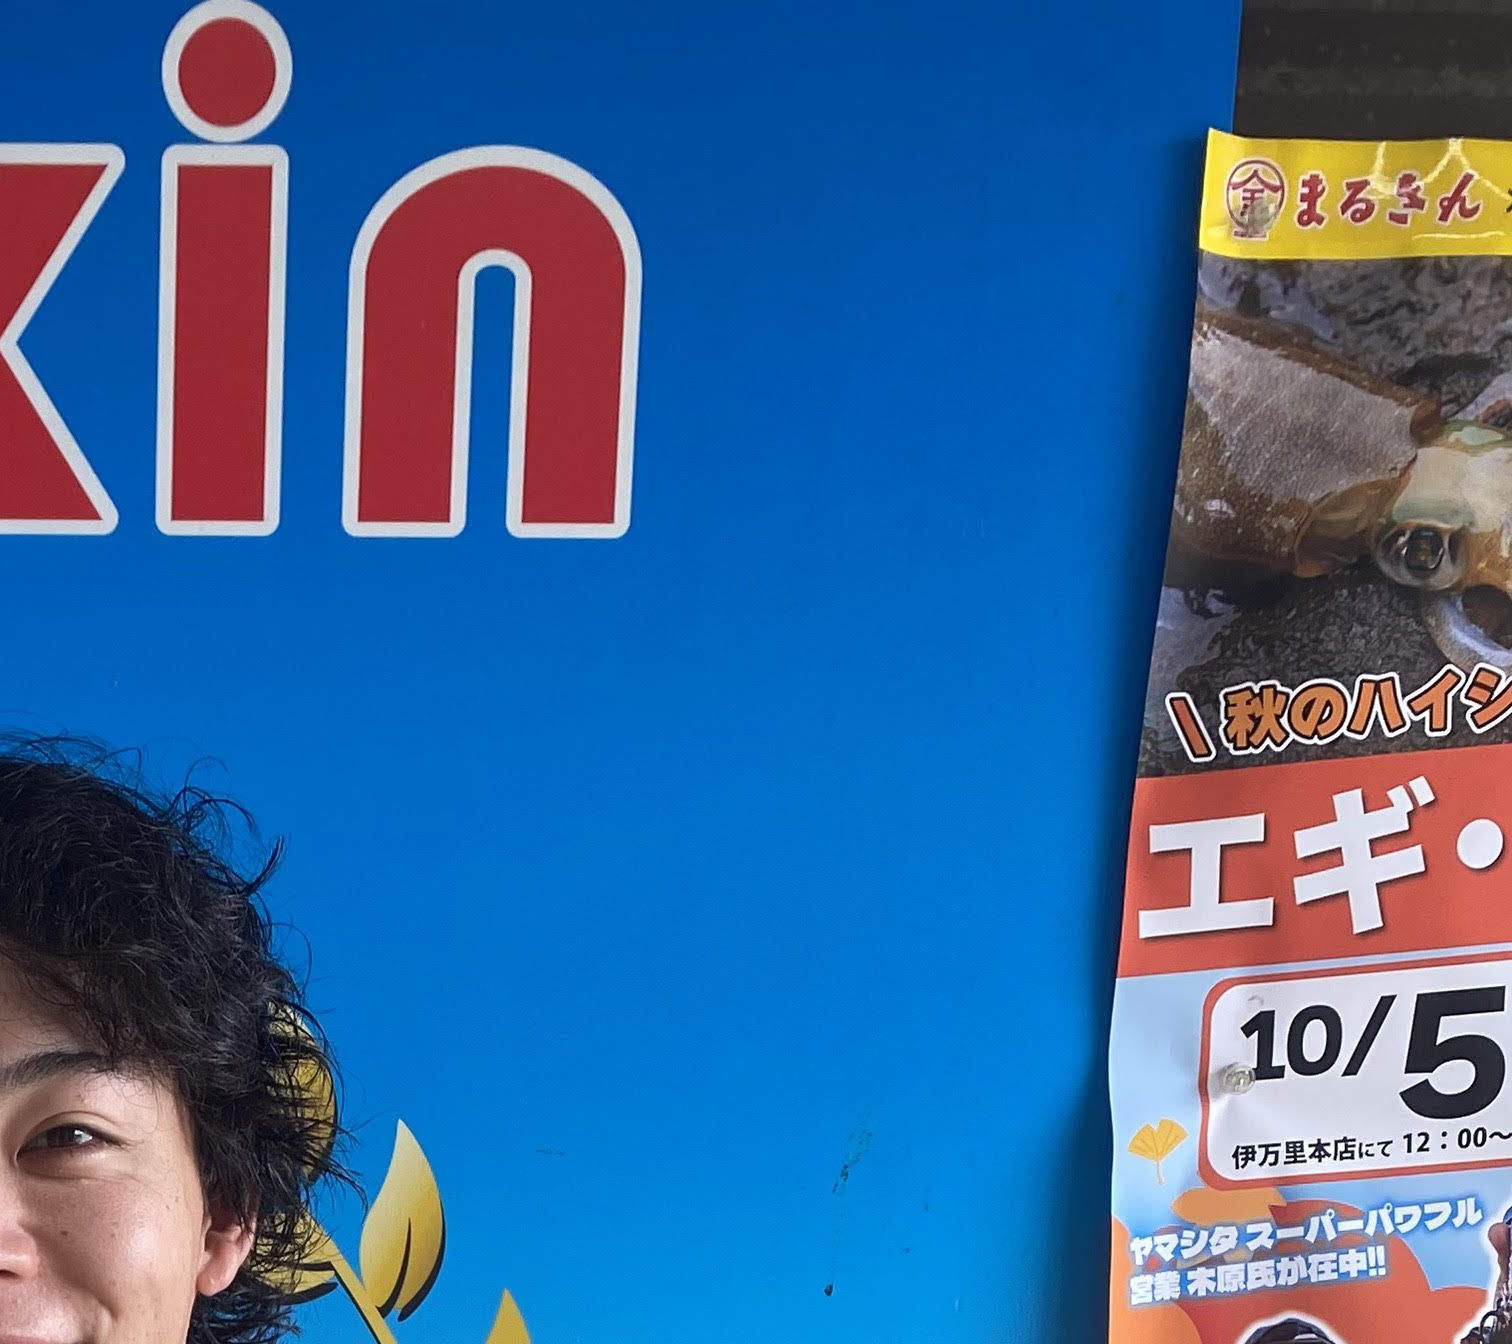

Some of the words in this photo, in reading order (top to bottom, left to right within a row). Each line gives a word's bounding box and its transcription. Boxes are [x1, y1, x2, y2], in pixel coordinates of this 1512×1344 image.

[1294, 172, 1482, 228] まるきん
[1239, 985, 1507, 1120] 10/5
[1231, 1136, 1393, 1170] 伊万里本店にて
[1130, 1226, 1238, 1266] ヤマシタ
[1245, 1197, 1484, 1252] スーパーパワフル
[1130, 1270, 1181, 1306] 営業
